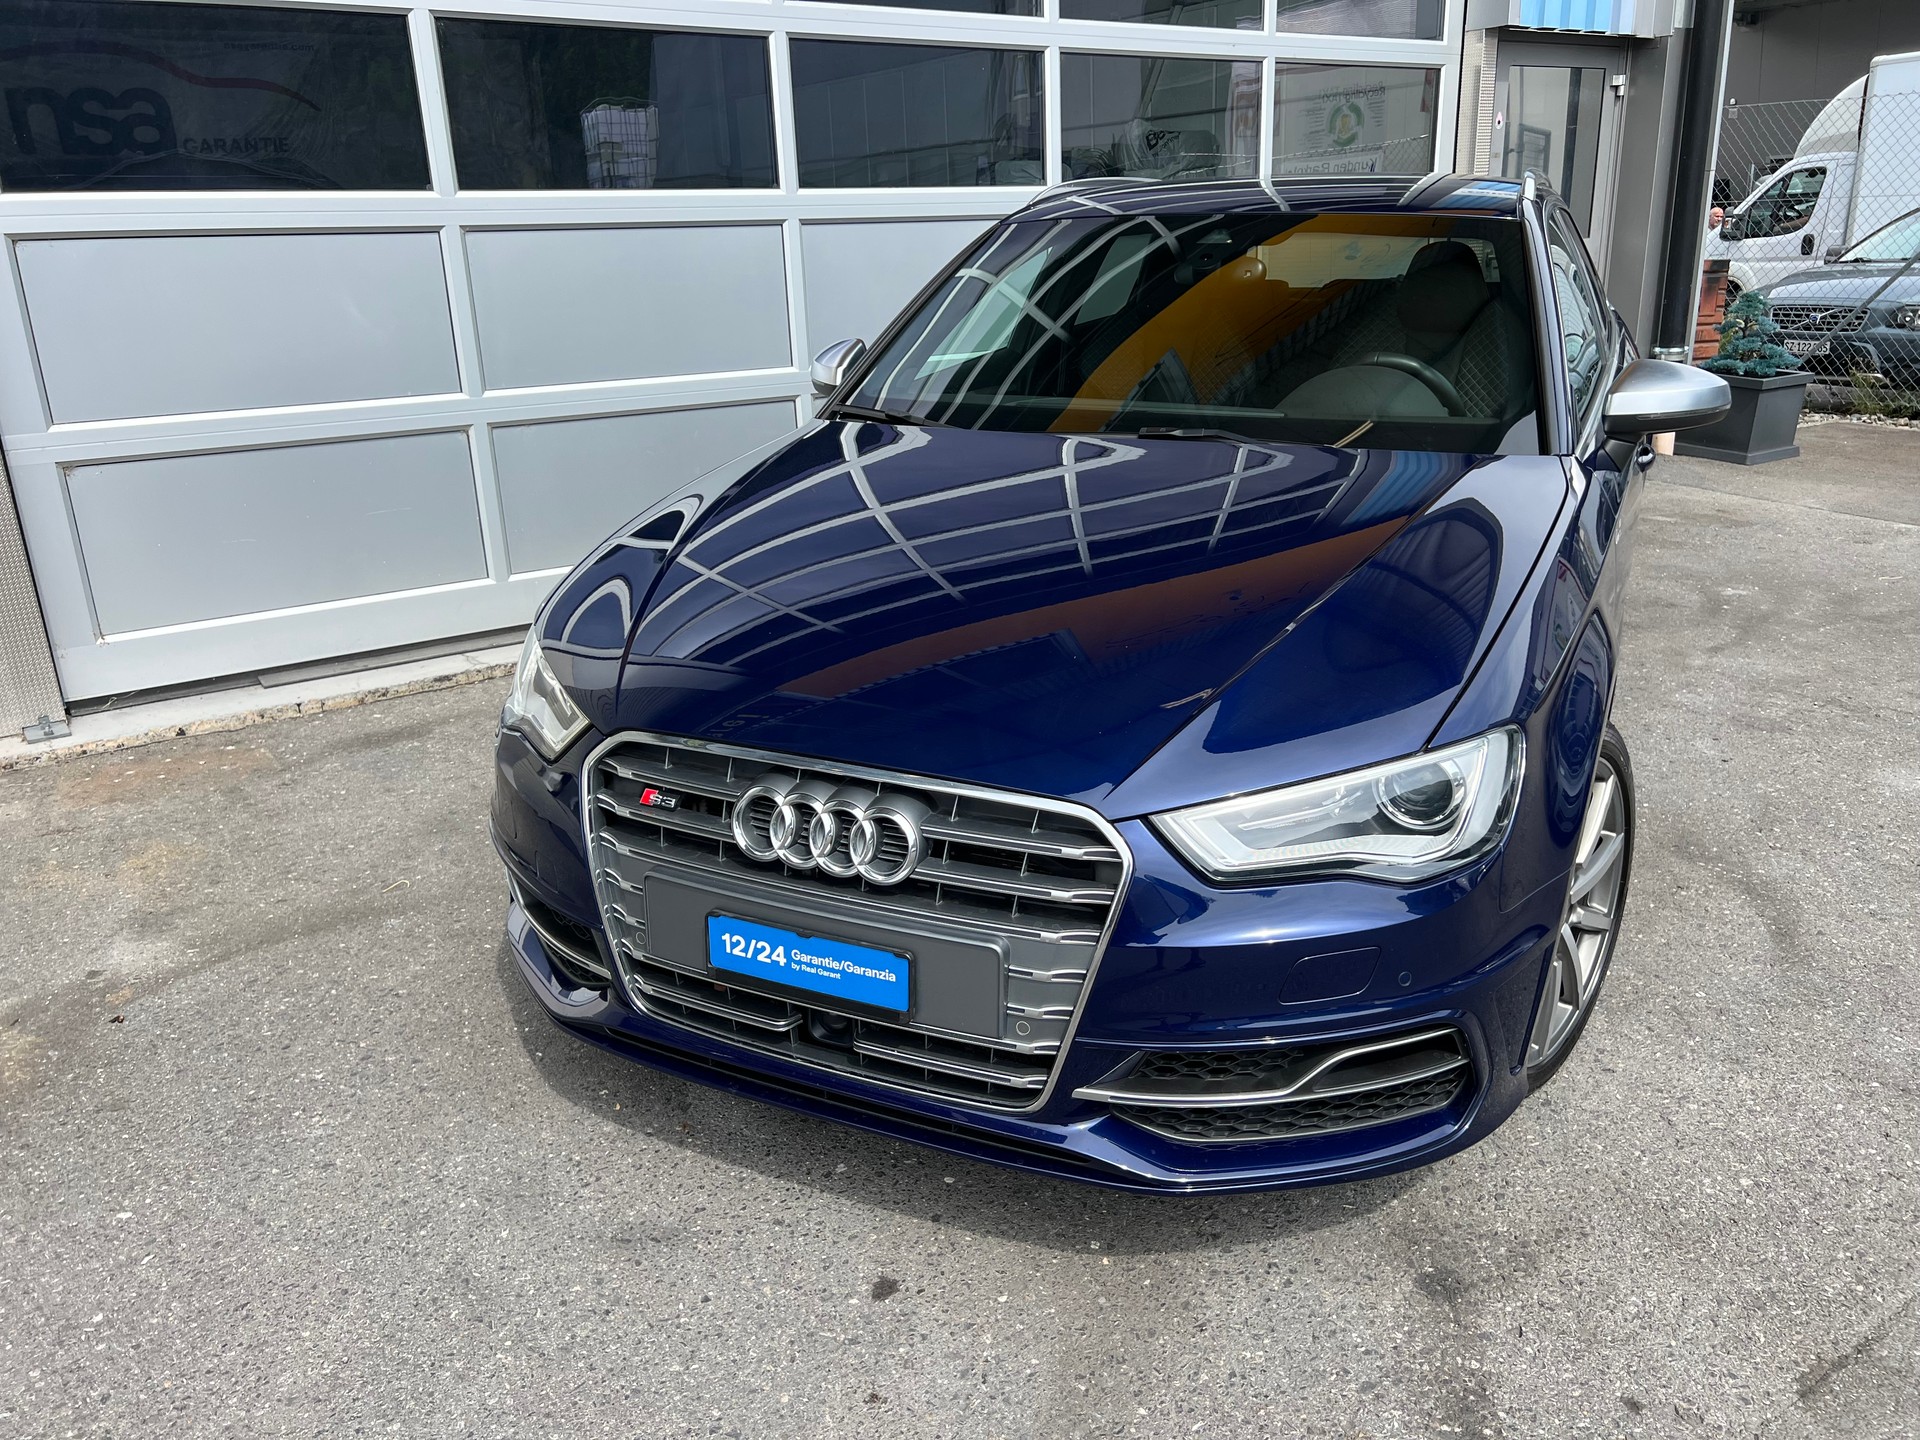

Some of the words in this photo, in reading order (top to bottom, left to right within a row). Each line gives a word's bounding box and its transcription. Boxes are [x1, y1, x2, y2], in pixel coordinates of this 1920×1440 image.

[4, 87, 178, 155] nsa
[183, 137, 289, 154] GARANTIE
[647, 791, 677, 809] S3
[721, 933, 787, 967] 12/24
[791, 949, 896, 982] Garantie/Garanzia
[791, 962, 801, 972] by
[801, 964, 817, 974] Real
[817, 968, 841, 980] Garant
